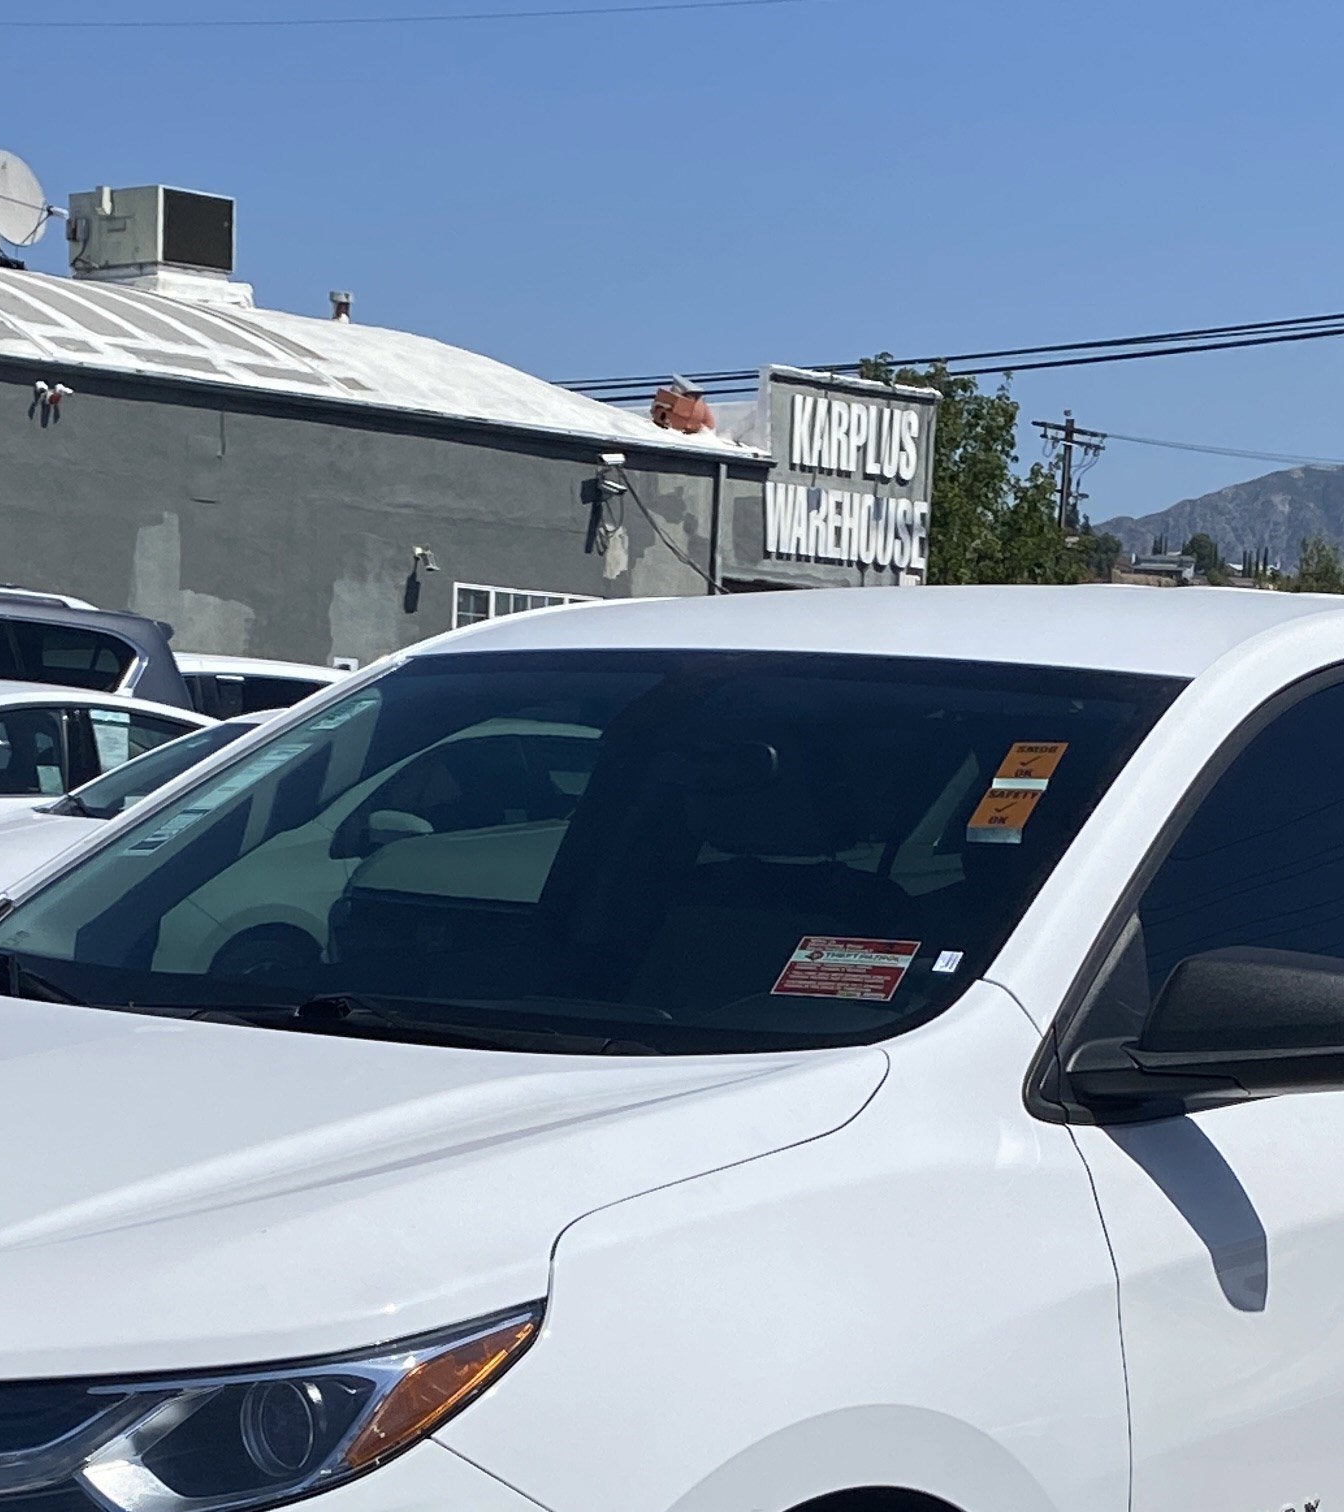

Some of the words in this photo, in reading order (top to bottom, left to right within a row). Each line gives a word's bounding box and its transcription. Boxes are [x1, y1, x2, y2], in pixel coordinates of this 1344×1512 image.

[792, 394, 919, 481] KARPLUS
[765, 481, 929, 570] WAREHOUSE
[987, 790, 1039, 799] SAFETY
